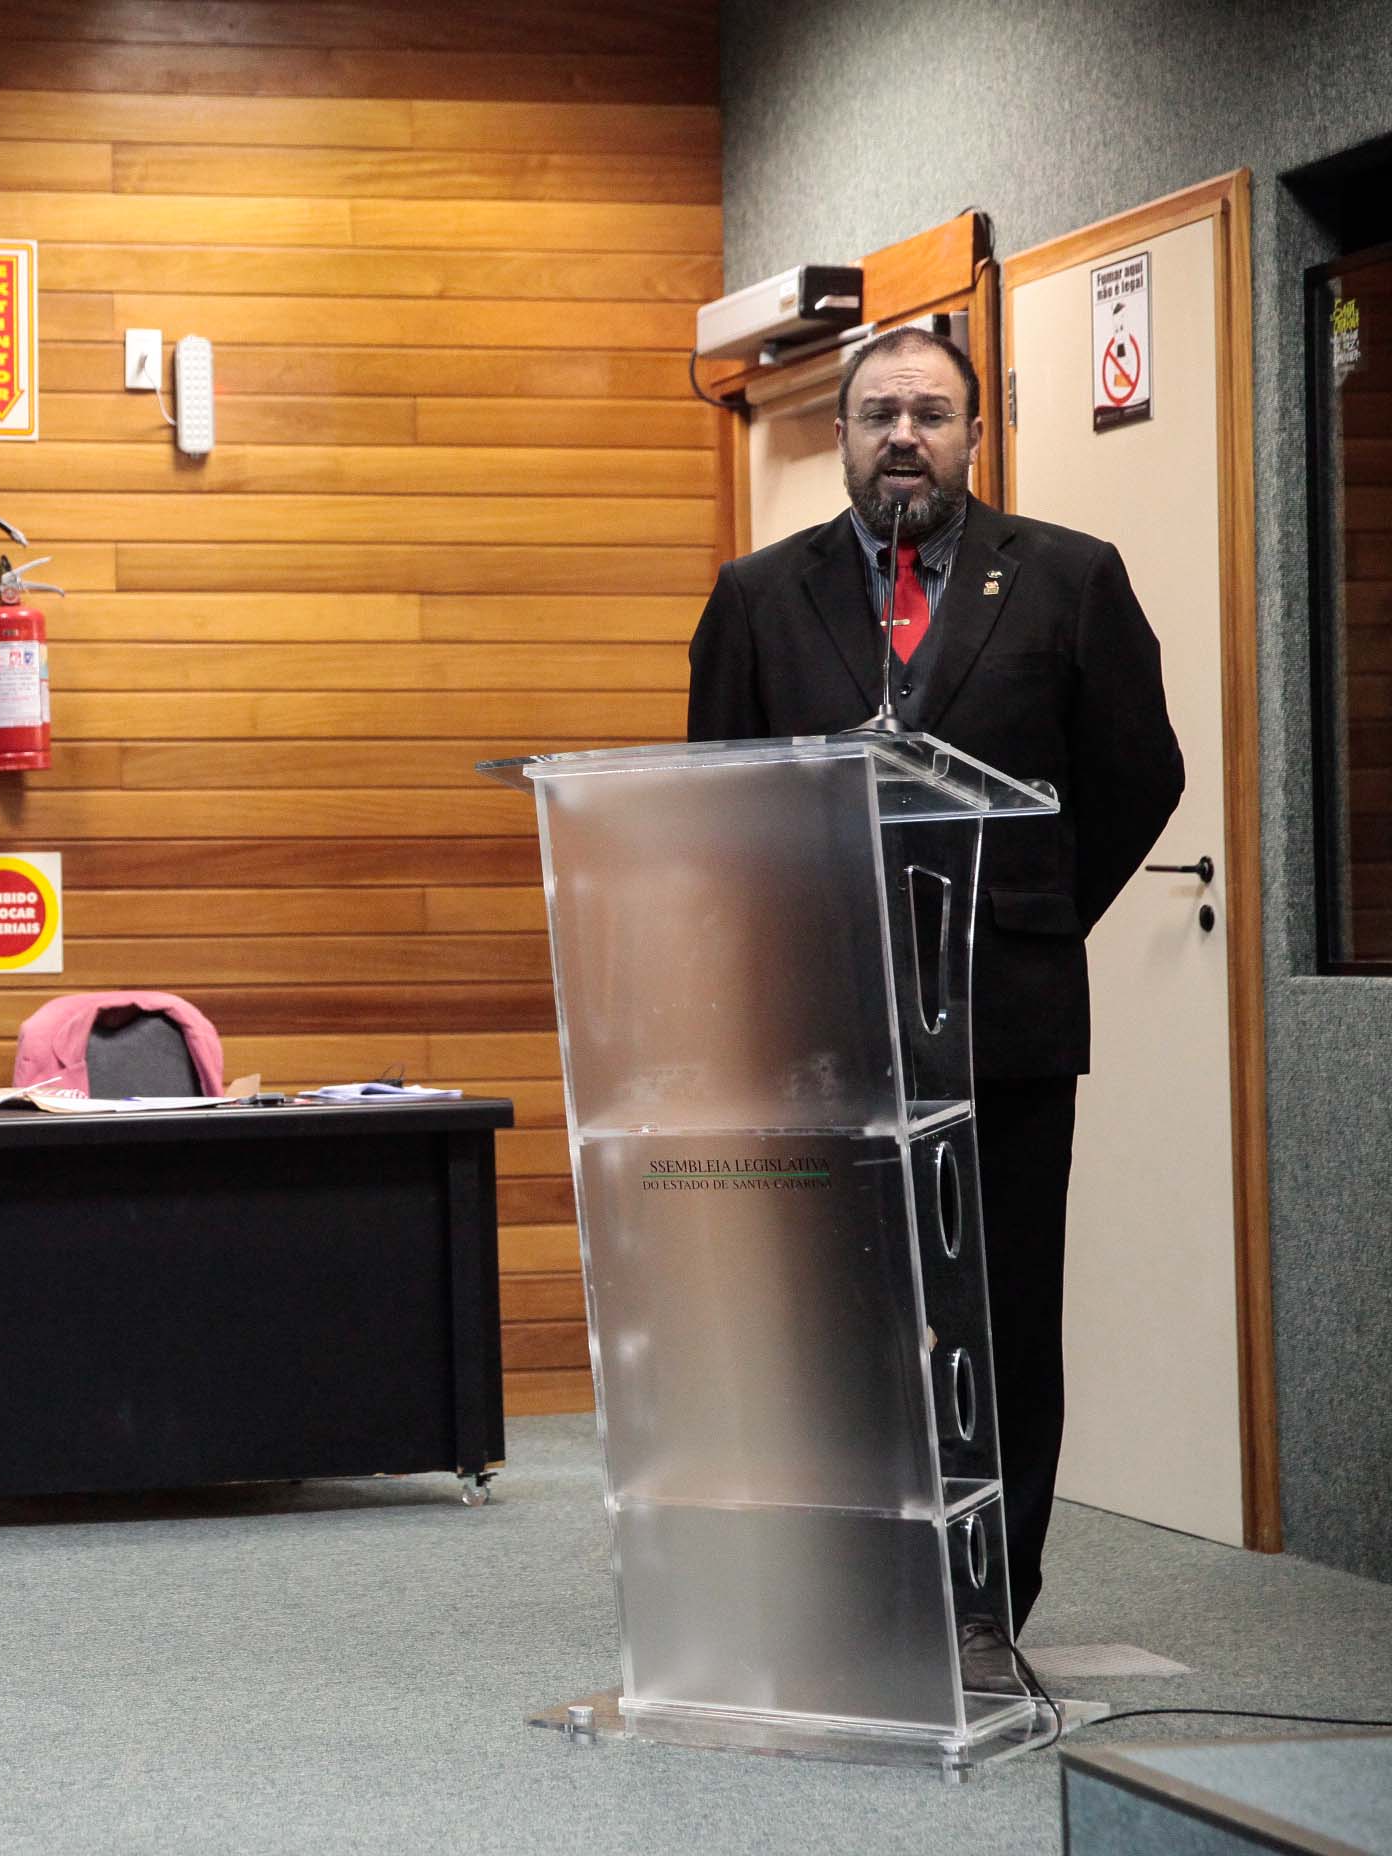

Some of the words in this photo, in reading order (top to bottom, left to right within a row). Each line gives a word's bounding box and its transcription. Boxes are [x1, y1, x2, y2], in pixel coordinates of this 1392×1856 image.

[1097, 268, 1122, 287] Fumar
[1124, 259, 1143, 278] aqui
[1121, 272, 1144, 293] legal
[735, 1157, 830, 1172] LEGISLATIVA
[642, 1180, 659, 1191] DO
[663, 1180, 709, 1190] ESTADO
[713, 1179, 729, 1190] DE
[733, 1179, 770, 1190] SANTA
